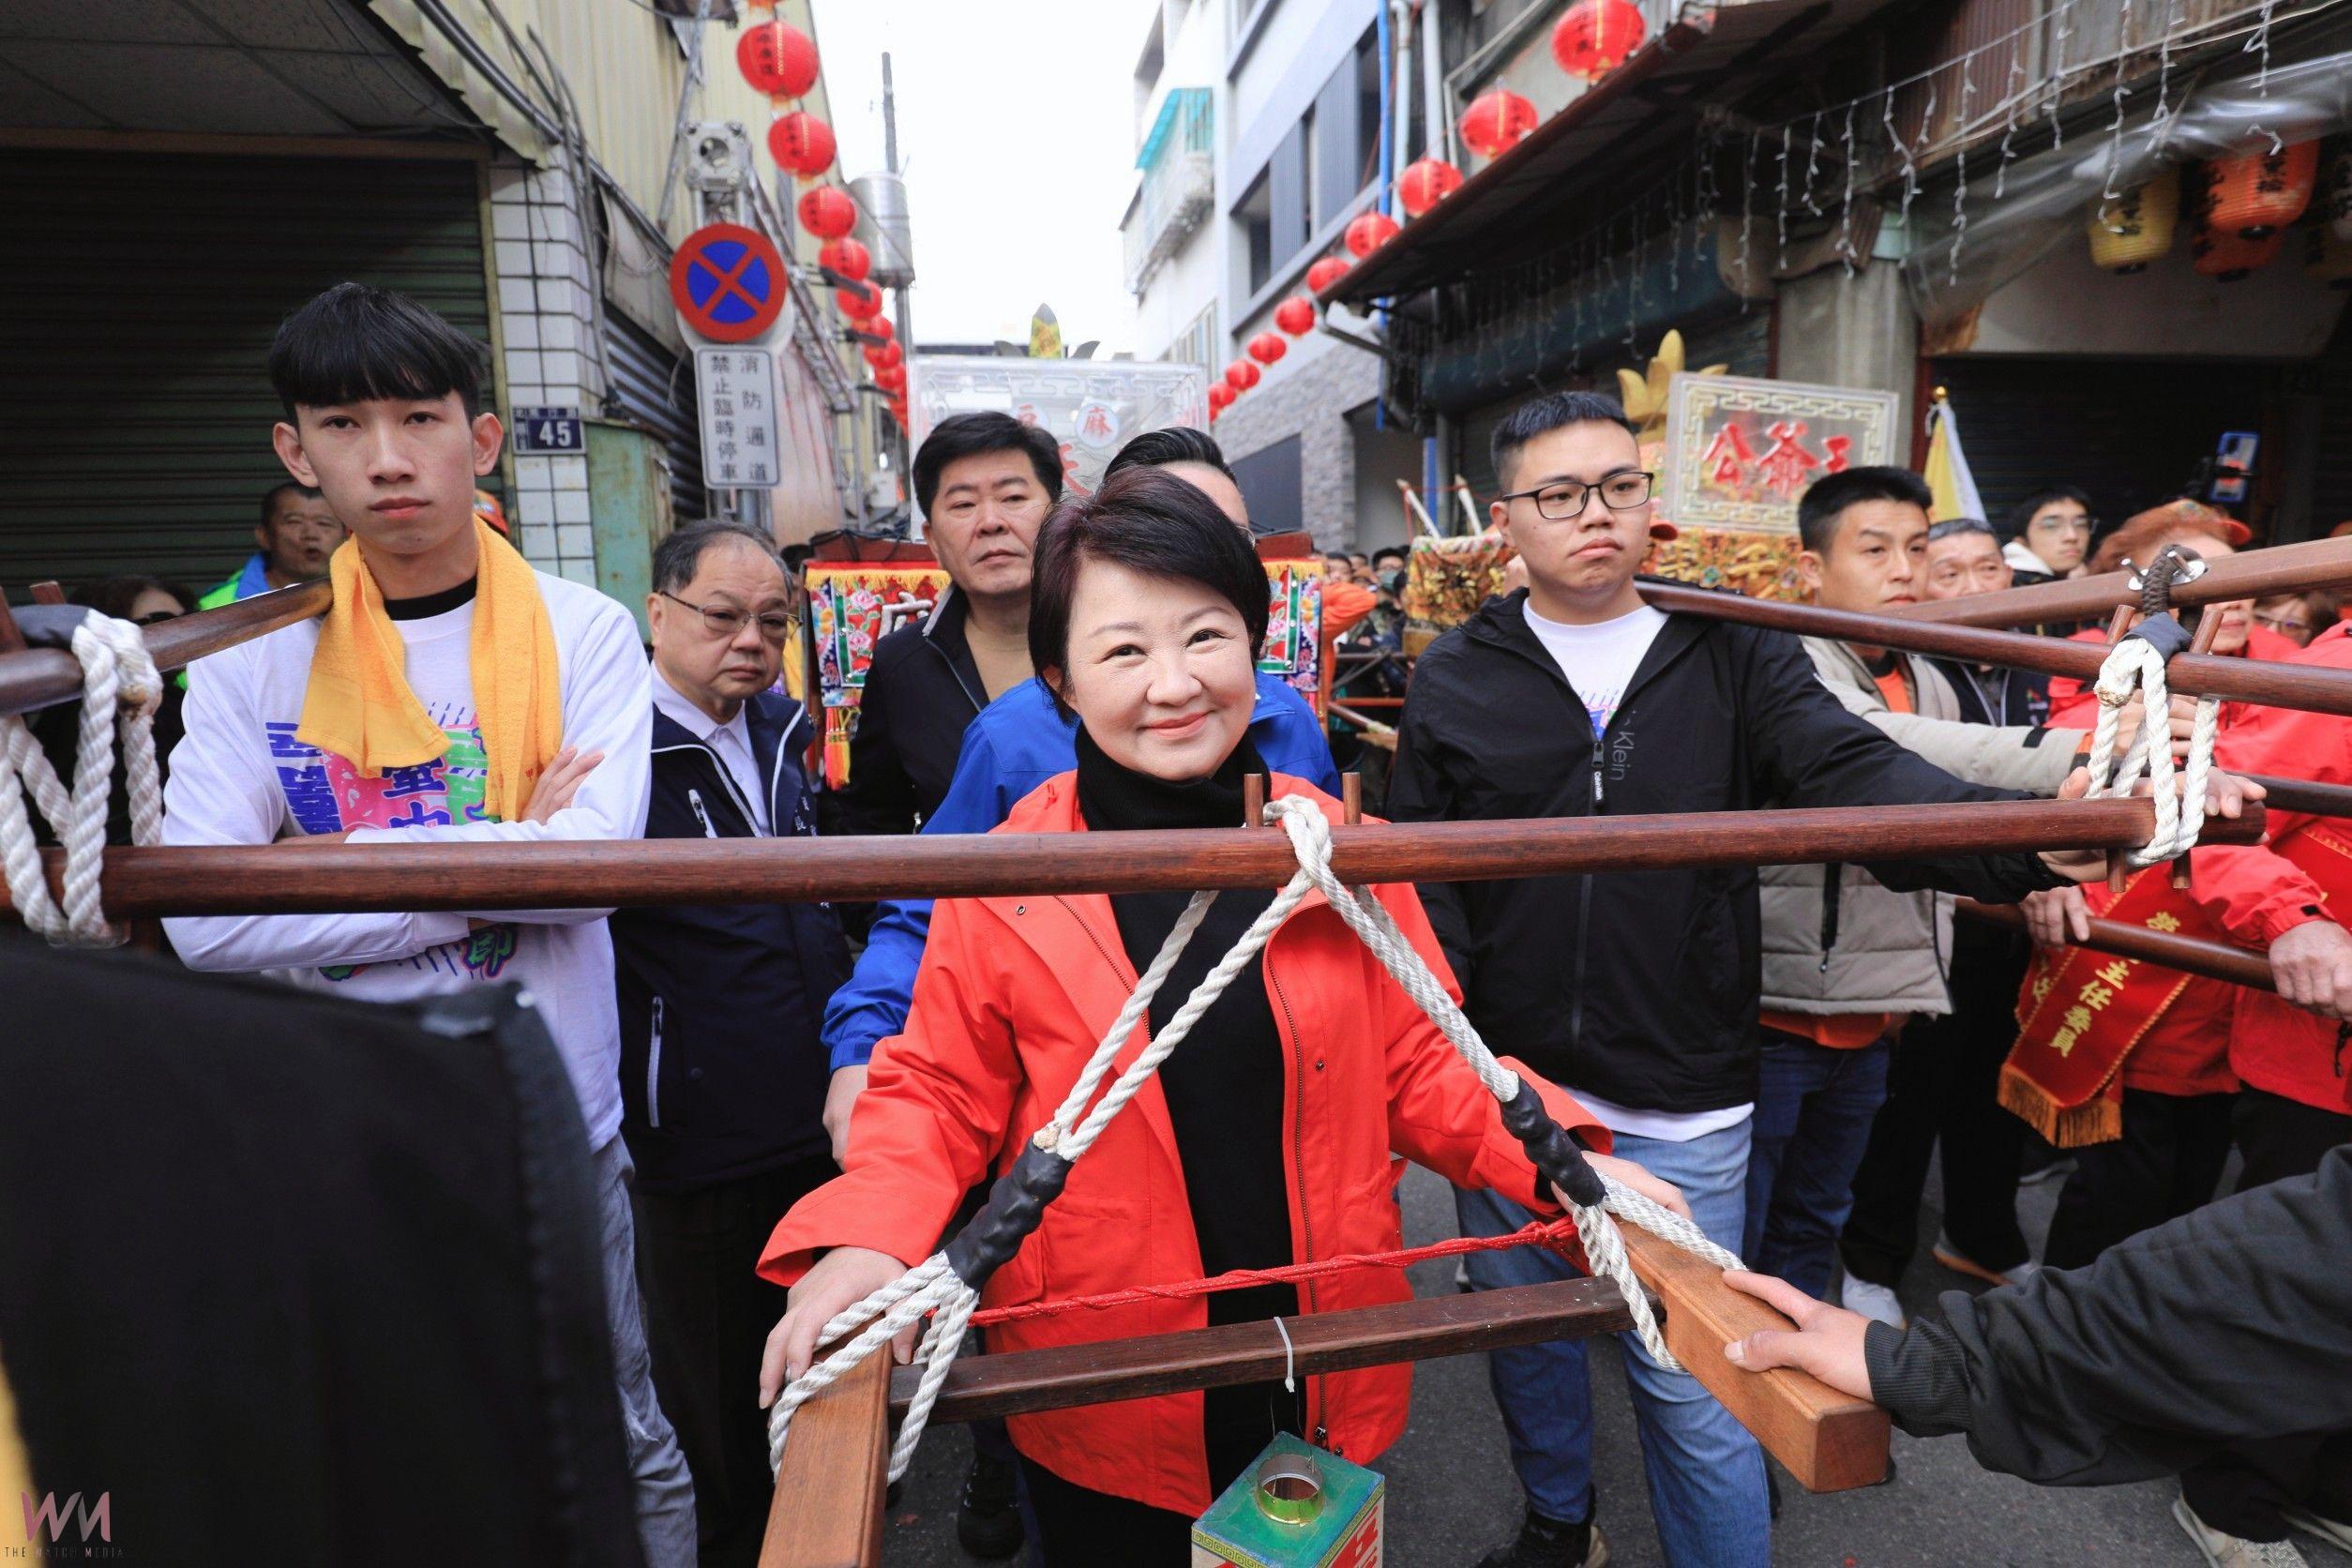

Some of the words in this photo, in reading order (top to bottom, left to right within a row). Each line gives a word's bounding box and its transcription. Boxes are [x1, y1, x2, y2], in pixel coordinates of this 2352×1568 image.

[538, 419, 572, 447] 45
[710, 354, 737, 480] 禁止臨時停車
[739, 354, 767, 481] 消防通道
[1609, 731, 1636, 781] Klein
